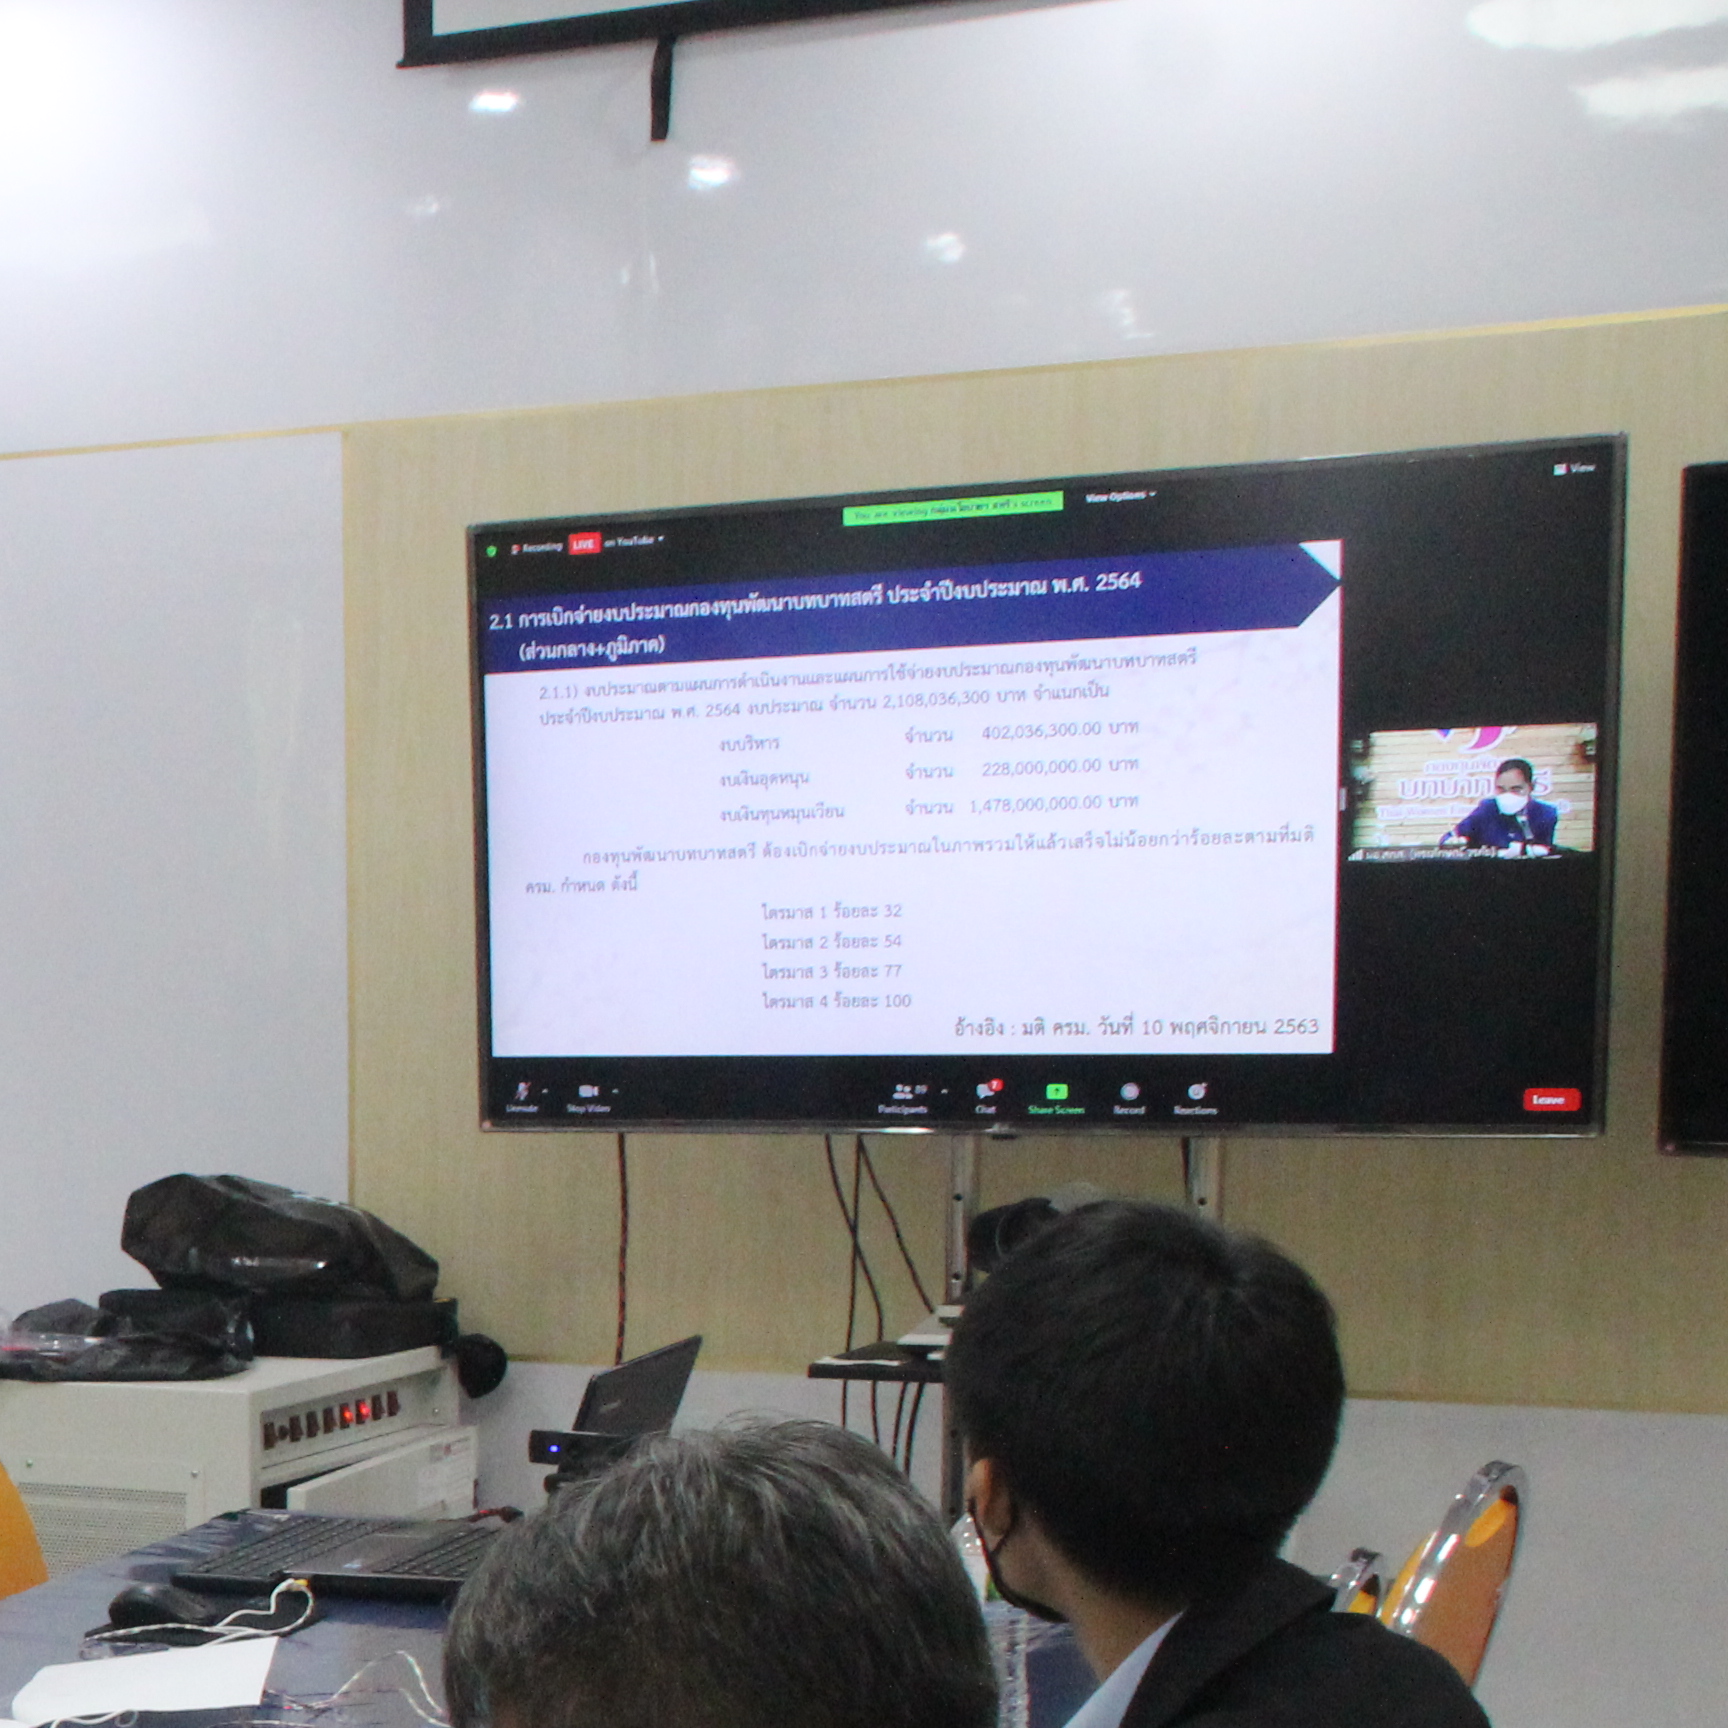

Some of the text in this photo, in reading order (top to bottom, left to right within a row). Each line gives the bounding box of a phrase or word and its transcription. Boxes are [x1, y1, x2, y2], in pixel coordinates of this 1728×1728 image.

[572, 538, 595, 550] LIVE
[489, 571, 1143, 630] 2.1 การเบิกจ่ายงบประมาณกองทุนพัฒนาบทบาทสตรี ประจำปีงบประมาณ พ.ศ. 2564
[518, 634, 666, 662] (ส่วนกลาง+ภูมิภาค)
[539, 685, 578, 700] 2.1.1)
[539, 678, 1109, 727] ประจำปีงบประมาณ พ.ศ. 2564 งบประมาณ จำนวน 2,108,036,300 บาท จำแนกเป็น
[904, 720, 1140, 744] จำนวน 402,036,300.00 บาท
[719, 734, 780, 753] งบบริหาร
[904, 757, 1140, 780] จำนวน 228,000,000.00 บาท
[719, 769, 810, 790] งบเงินอุดหนุน
[719, 801, 845, 825] งบเงินทุนหมุนเวียน
[904, 794, 1140, 816] จำนวน 1,478,000,000.00 บาท
[582, 840, 758, 869] กองทุนพัฒนาบทบาทสตรี
[525, 869, 639, 894] ครม. กำหนด ดังนี้
[761, 902, 903, 921] ไตรมาส 1 ร้อยละ 32
[761, 932, 903, 951] ไตรมาส 2 ร้อยละ 54
[761, 962, 904, 981] ไตรมาส 3 ร้อยละ 77
[761, 992, 913, 1011] ไตรมาส 4 ร้อยละ 100
[954, 1015, 1005, 1037] อ้างอิง
[1021, 1016, 1046, 1037] มติ
[1052, 1021, 1091, 1037] ครม.
[1097, 1010, 1135, 1037] วันที่
[1141, 1019, 1163, 1036] 10
[1170, 1014, 1267, 1039] พฤศจิกายน
[1273, 1018, 1320, 1036] 2563
[975, 1104, 996, 1114] Chat
[1532, 1094, 1566, 1105] Leave
[878, 1104, 929, 1116] Participants
[1027, 1104, 1086, 1115] Share Screen
[1113, 1104, 1146, 1115] Record
[1173, 1104, 1219, 1116] Reactions
